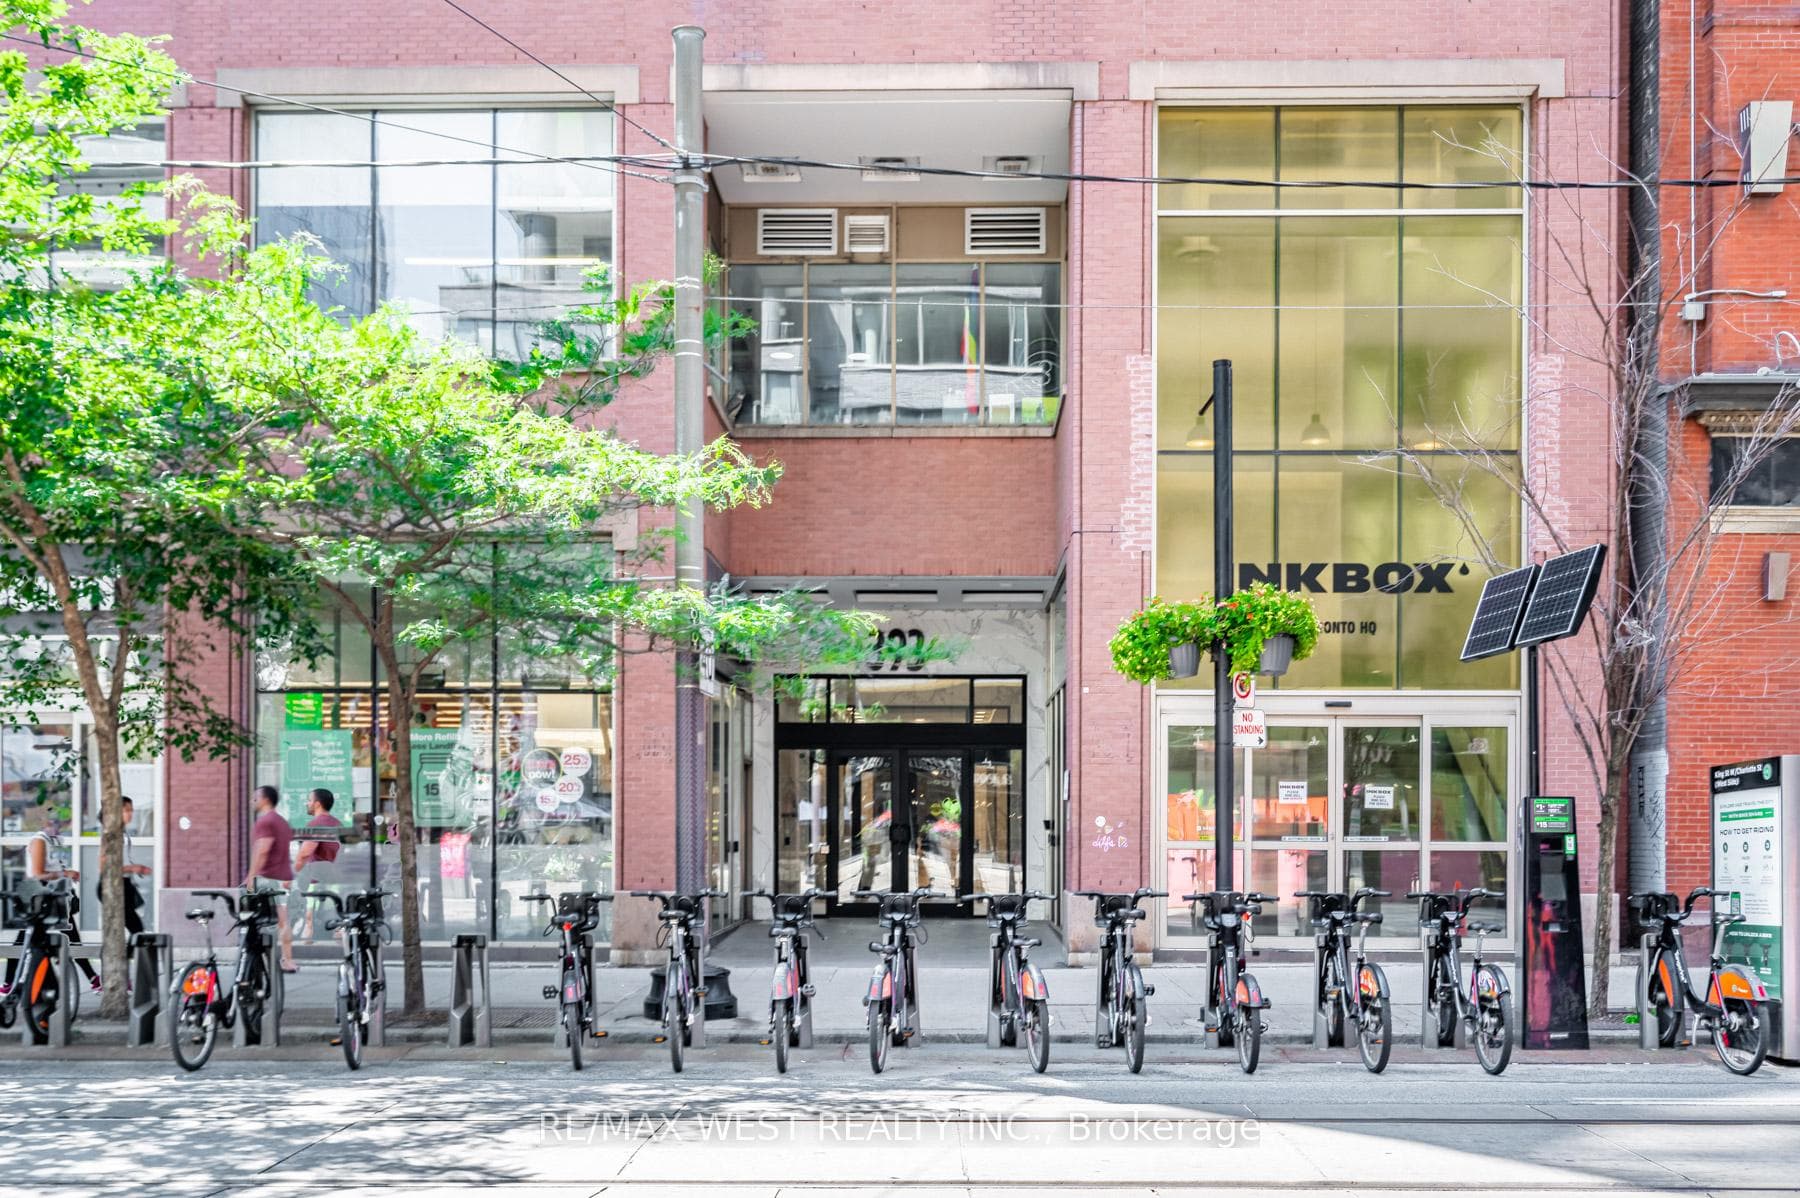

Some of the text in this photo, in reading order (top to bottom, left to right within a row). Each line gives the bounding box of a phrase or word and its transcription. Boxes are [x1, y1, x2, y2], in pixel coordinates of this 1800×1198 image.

[1232, 562, 1455, 593] NKBOX
[1320, 622, 1377, 635] ONTO HQ
[1242, 713, 1253, 723] NO
[1233, 725, 1264, 734] STANDING
[1714, 770, 1724, 779] King
[1720, 828, 1732, 836] HOW
